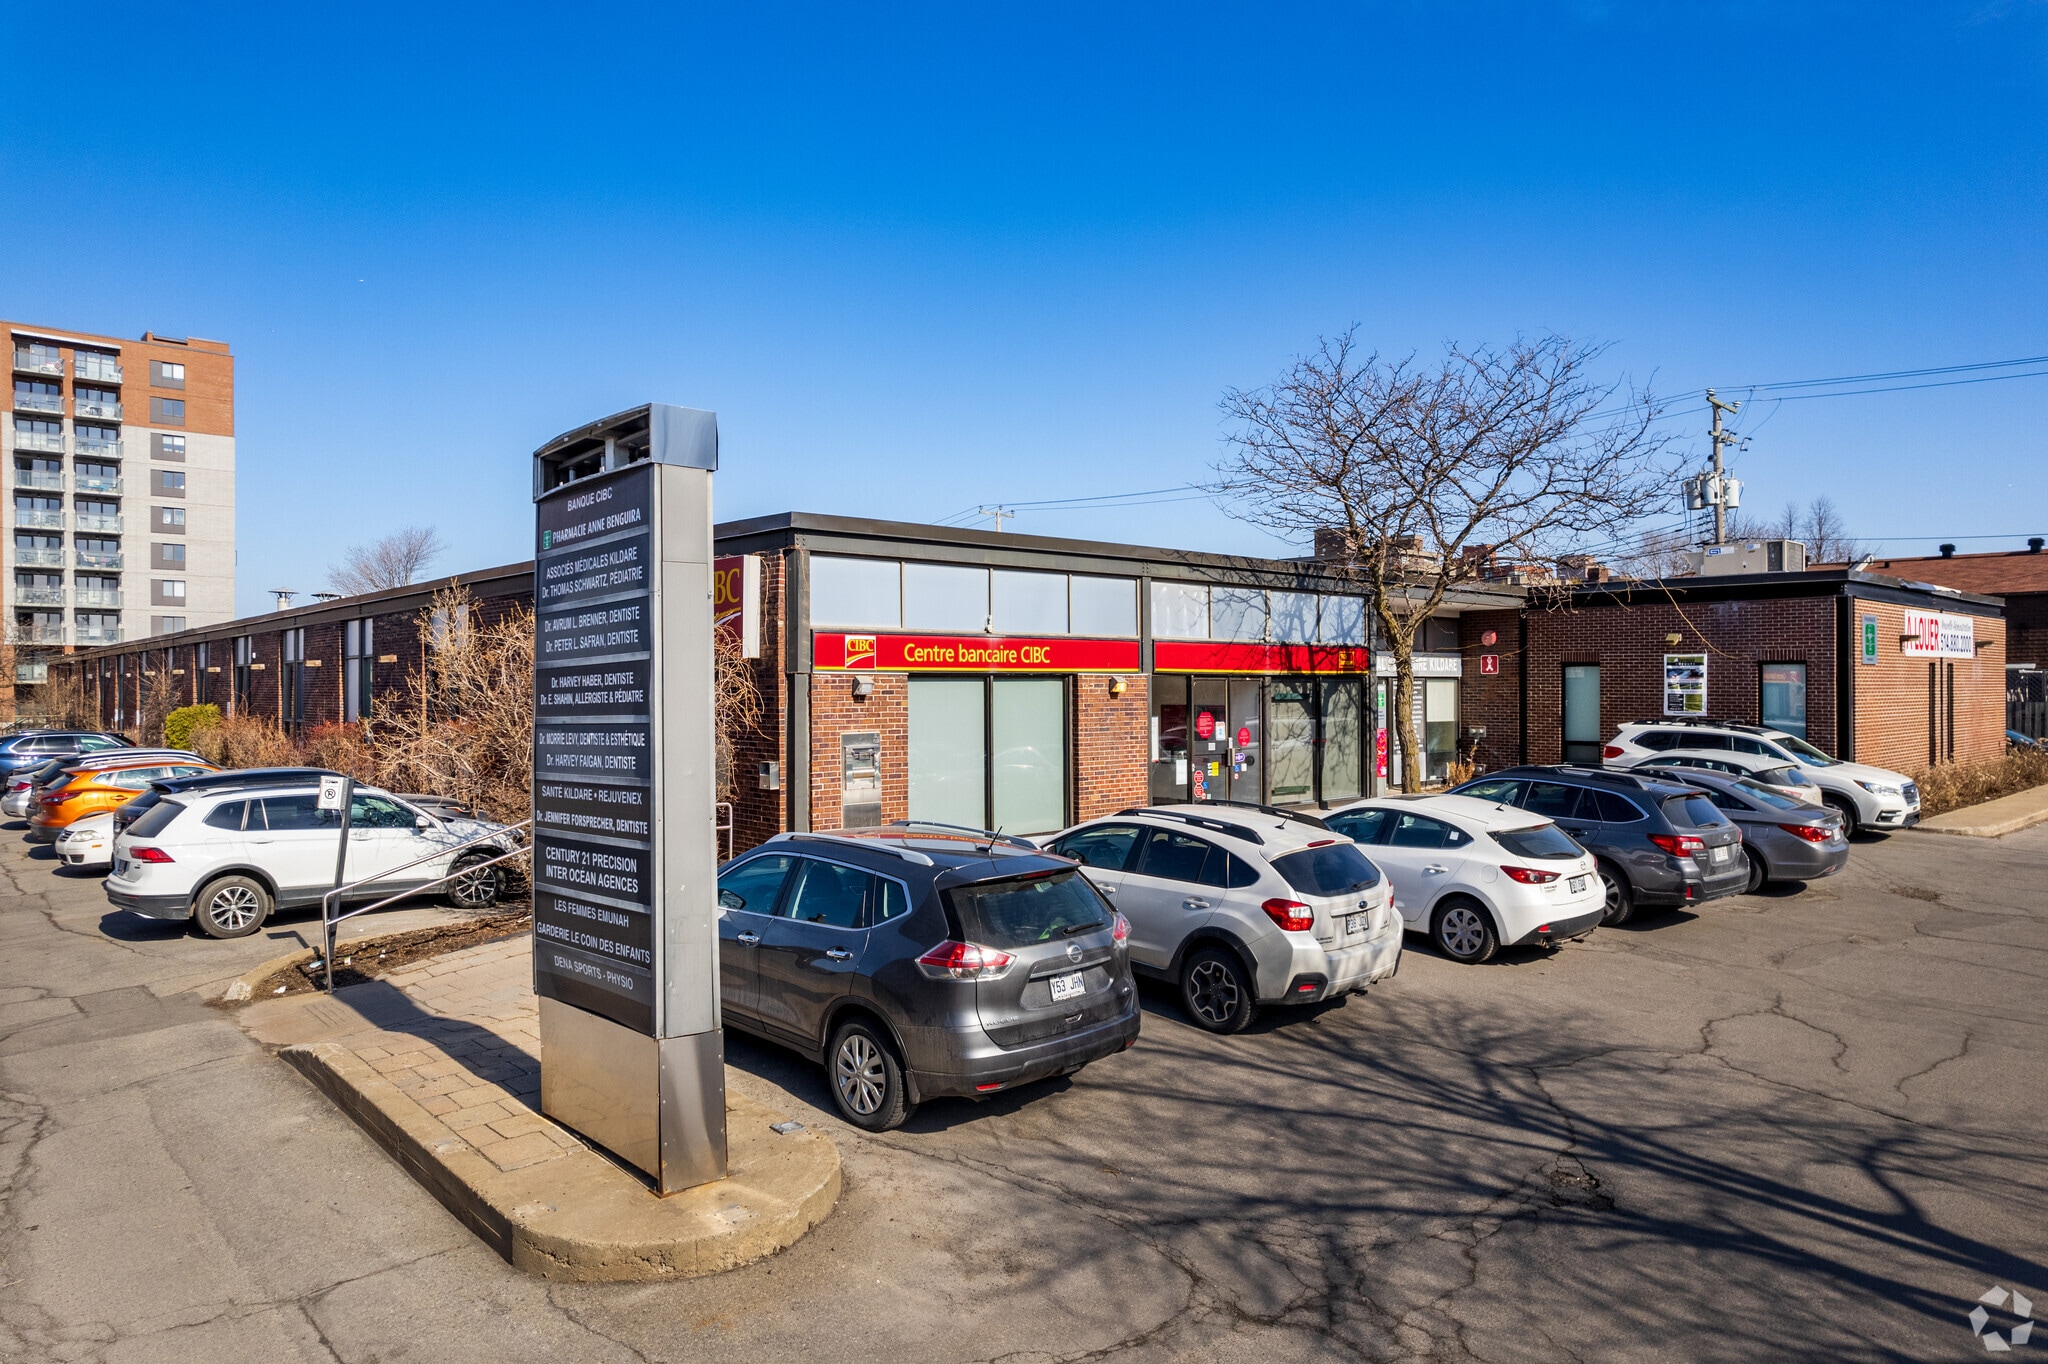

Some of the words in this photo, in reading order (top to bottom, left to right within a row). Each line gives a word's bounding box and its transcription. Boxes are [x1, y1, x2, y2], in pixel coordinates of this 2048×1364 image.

[568, 492, 594, 511] BANQUE
[596, 487, 613, 501] CIBC
[552, 524, 586, 544] PHARMACIE
[588, 518, 605, 534] ANNE
[606, 508, 641, 528] BENGUIRA
[546, 560, 574, 579] ASSOCIÉS
[574, 556, 608, 573] MÉDICALES
[610, 547, 637, 565] KILDARE
[542, 587, 550, 598] Dr.
[550, 582, 573, 598] THOMAS
[574, 574, 608, 594] SCHWARTZ,
[610, 566, 642, 585] PÉDIATRIE
[544, 620, 552, 632] Dr.
[552, 616, 572, 631] AVRUM
[572, 615, 578, 628] L.
[578, 611, 608, 627] BRENNER,
[610, 606, 640, 623] DENTISTE
[554, 638, 573, 651] PETER
[574, 638, 579, 650] L.
[580, 634, 606, 649] SAFRAN,
[607, 630, 638, 646] DENTISTE
[848, 639, 874, 651] CIBC
[1914, 617, 1939, 651] LOUER
[904, 644, 954, 662] Centre
[959, 644, 1017, 663] bancaire
[1021, 646, 1050, 663] CIBC
[1430, 658, 1457, 671] KILDARE
[560, 675, 582, 688] HARVEY
[582, 674, 604, 688] HABER,
[604, 672, 634, 685] DENTISTE
[548, 694, 553, 705] E.
[575, 691, 608, 704] ALLERGISTE
[610, 692, 614, 703] &
[615, 688, 644, 703] PÉDIATRE
[546, 733, 565, 745] MORRIE
[566, 733, 579, 747] LEVY,
[580, 733, 605, 746] DENTISTE
[606, 734, 610, 745] &
[610, 730, 645, 746] ESTHÉTIQUE
[555, 755, 579, 767] HARVEY
[579, 755, 604, 770] FAIGAN,
[604, 756, 636, 769] DENTISTE
[541, 784, 562, 798] SANTÉ
[564, 787, 593, 800] KILDARE
[598, 790, 642, 805] REJUVENEX
[536, 810, 544, 822] Dr.
[544, 811, 570, 825] JENNIFER
[571, 814, 615, 833] FORSPRECHER,
[616, 819, 648, 835] DENTISTE
[546, 847, 580, 864] CENTURY
[582, 852, 590, 865] 21
[592, 852, 637, 873] PRECISION
[546, 864, 568, 881] INTER
[569, 866, 596, 886] OCÉAN
[598, 873, 639, 893] AGENCES
[554, 899, 567, 913] LES
[568, 902, 597, 920] FEMMES
[598, 908, 629, 928] EMUNAH
[537, 922, 569, 941] GARDERIE
[571, 930, 579, 944] LE
[581, 932, 598, 948] COIN
[599, 937, 614, 953] DES
[615, 942, 650, 964] ENFANTS
[554, 955, 572, 970] DENA
[574, 961, 602, 979] SPORTS
[607, 971, 634, 990] PHYSIO
[1051, 980, 1066, 994] Y53
